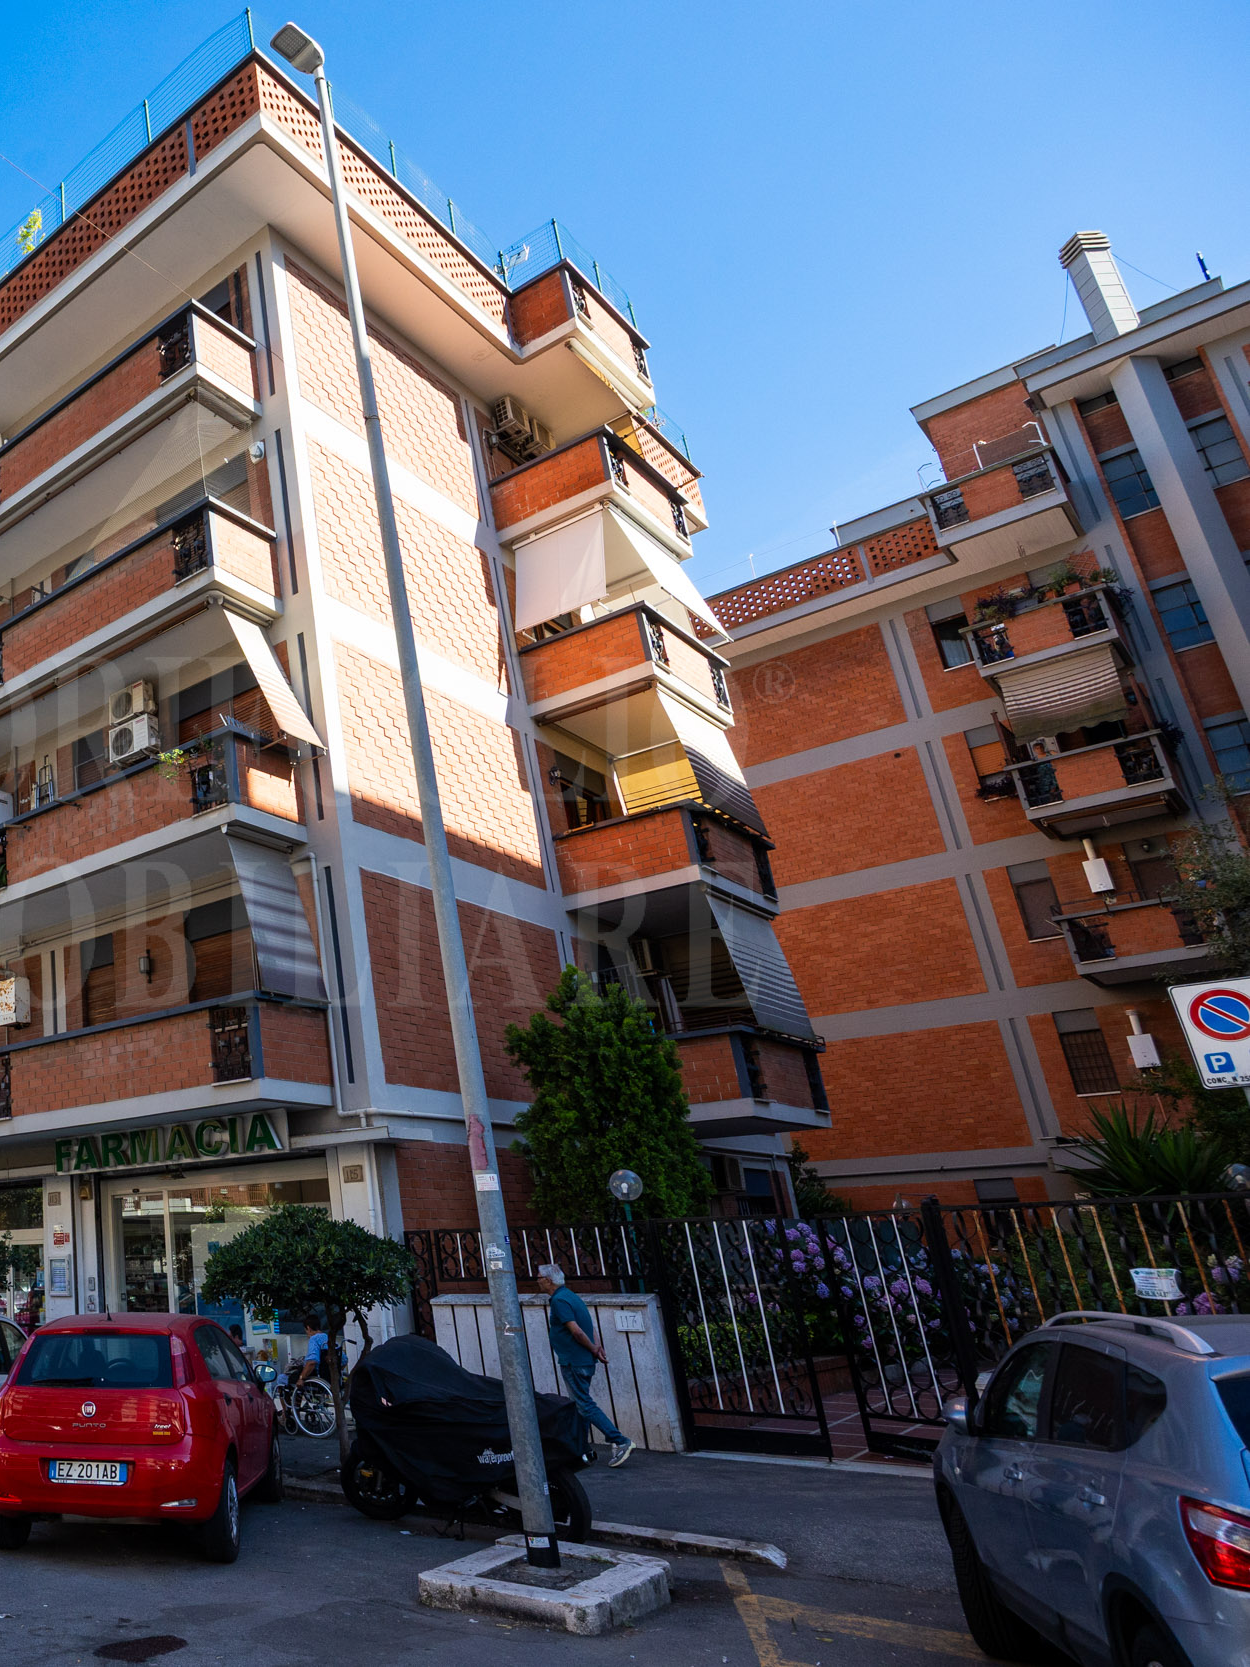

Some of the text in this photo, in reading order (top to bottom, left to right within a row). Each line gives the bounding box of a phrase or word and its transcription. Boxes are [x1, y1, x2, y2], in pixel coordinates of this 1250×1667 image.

[54, 1112, 283, 1173] FARMACIA
[619, 1315, 637, 1329] 117
[57, 1462, 118, 1480] EZ 201AB
